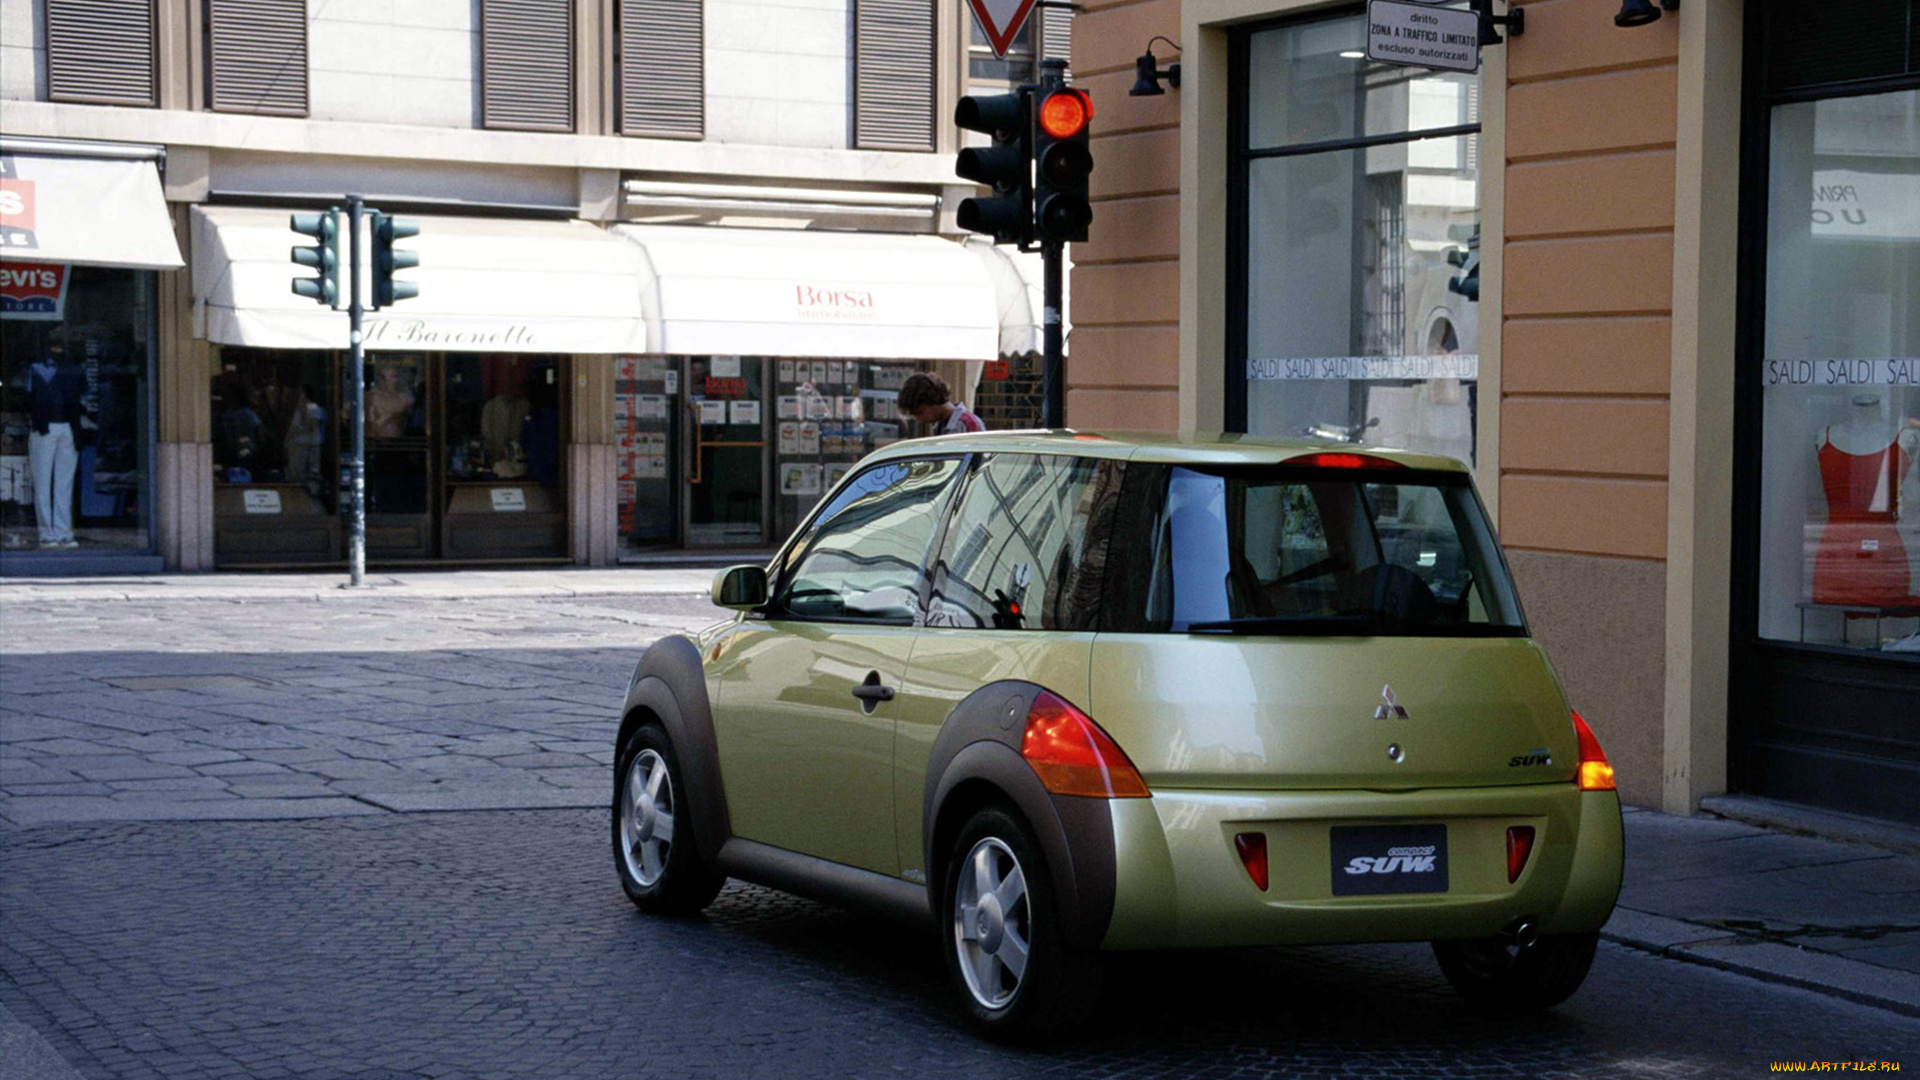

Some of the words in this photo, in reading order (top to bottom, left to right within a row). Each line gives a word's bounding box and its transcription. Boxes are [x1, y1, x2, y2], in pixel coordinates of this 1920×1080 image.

[1410, 13, 1438, 25] diritto
[1371, 24, 1391, 36] ZONA
[1394, 28, 1400, 37] A
[1402, 28, 1438, 42] TRAFFICO
[1442, 33, 1476, 47] LIMITATO
[1378, 43, 1415, 54] escluso
[1418, 48, 1468, 61] autorizzati
[0, 269, 57, 289] evi's
[796, 284, 873, 307] Borsa
[5, 302, 45, 311] TORE
[1251, 358, 1279, 379] SALDI
[1285, 358, 1315, 379] SALDI
[1321, 358, 1351, 379] SALDI
[1361, 358, 1392, 379] SALDI
[1400, 357, 1433, 378] SALDI
[1441, 356, 1475, 378] SALDI
[1770, 360, 1815, 385] SALDI
[1826, 360, 1875, 385] SALDI
[1887, 359, 1920, 385] SAL
[1388, 846, 1435, 857] compact
[1344, 855, 1436, 874] SUW
